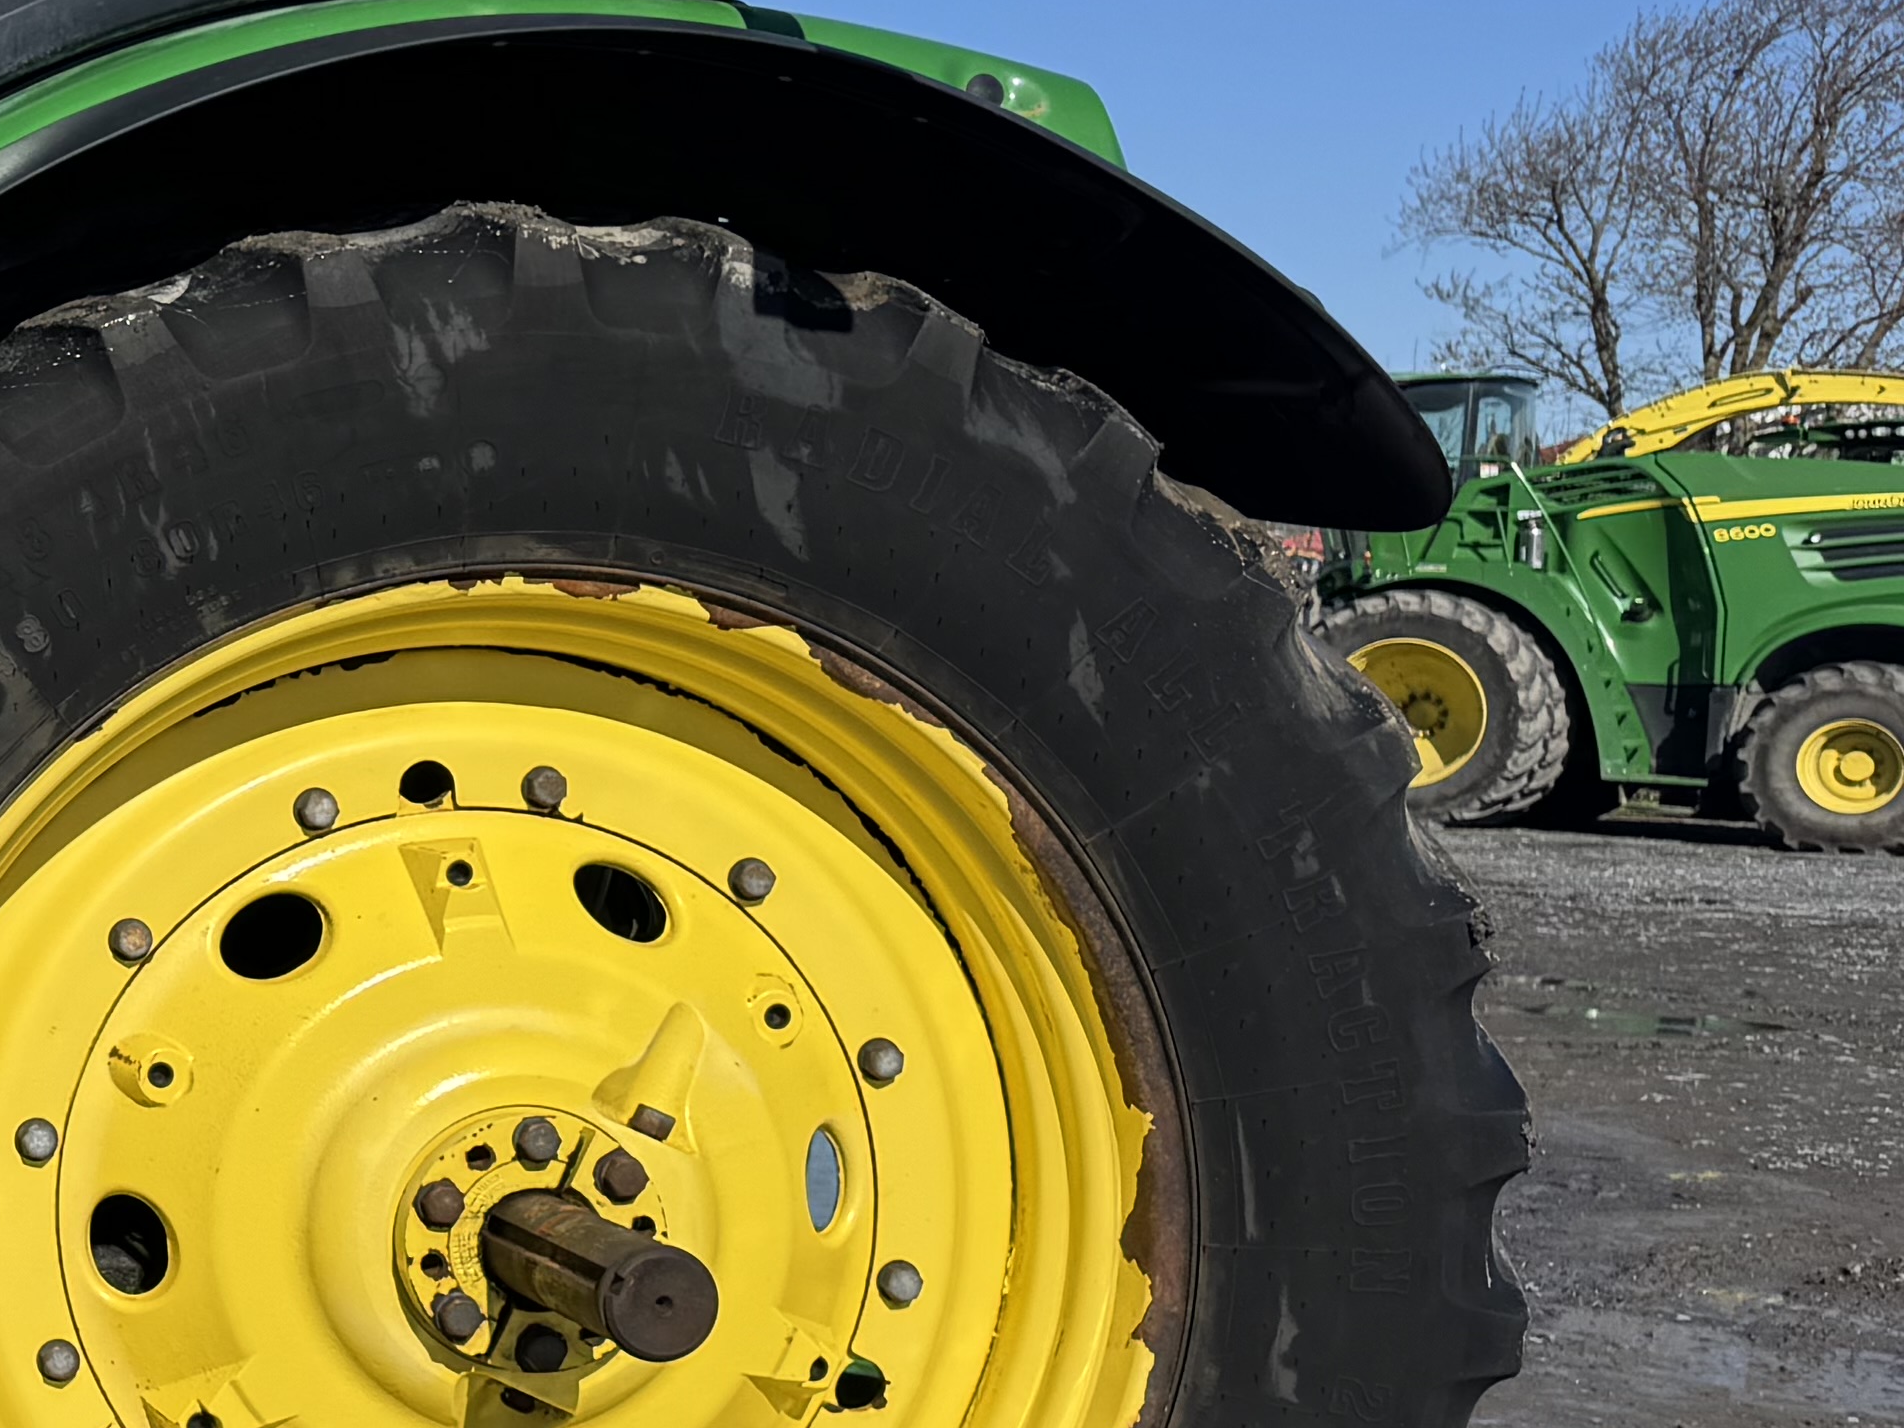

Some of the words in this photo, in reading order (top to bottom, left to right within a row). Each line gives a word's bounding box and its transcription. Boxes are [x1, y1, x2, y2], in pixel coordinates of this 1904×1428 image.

[711, 383, 1069, 593] RADIAL
[1089, 594, 1251, 773] ALL
[1247, 802, 1413, 1299] TRACTION
